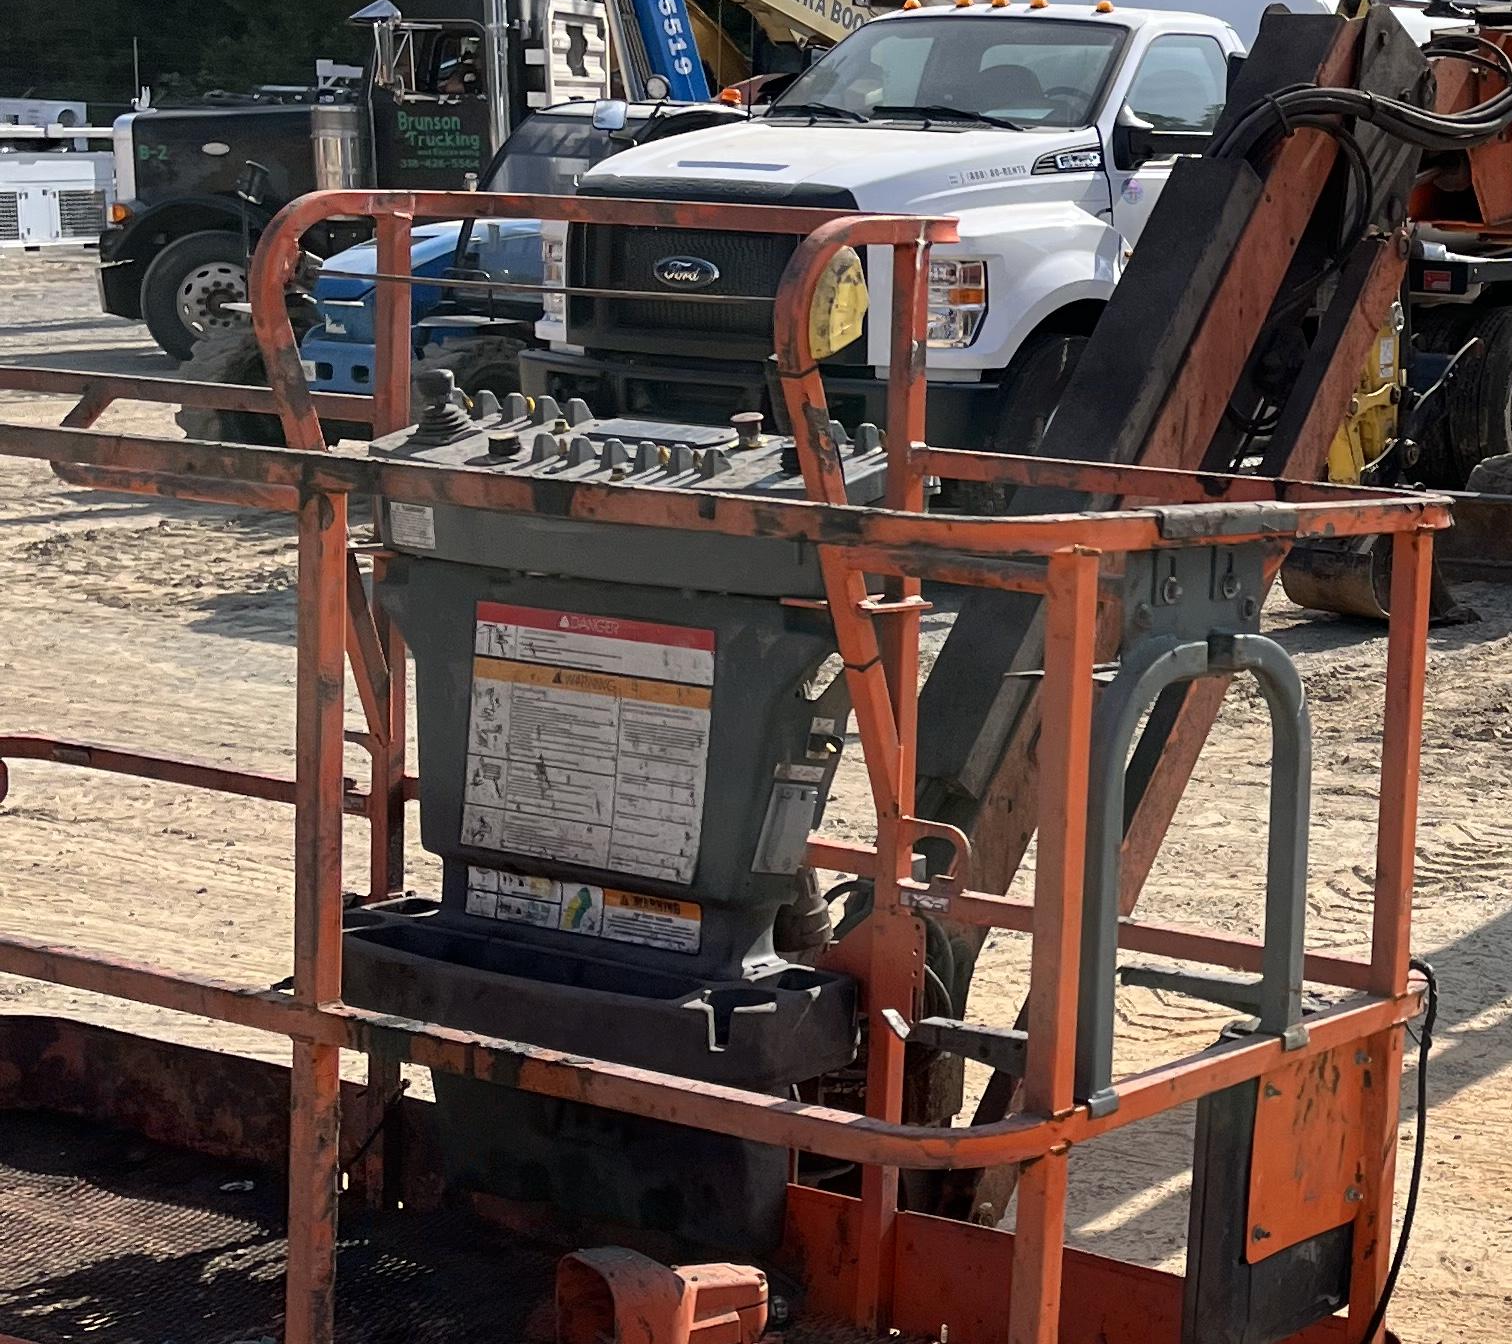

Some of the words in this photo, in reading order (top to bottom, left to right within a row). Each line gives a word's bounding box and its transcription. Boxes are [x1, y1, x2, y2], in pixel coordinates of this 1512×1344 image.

[397, 110, 461, 131] Brunson
[404, 131, 481, 150] Trucking
[137, 144, 169, 161] B-2
[570, 615, 620, 635] DANGER
[564, 671, 617, 692] WARNING
